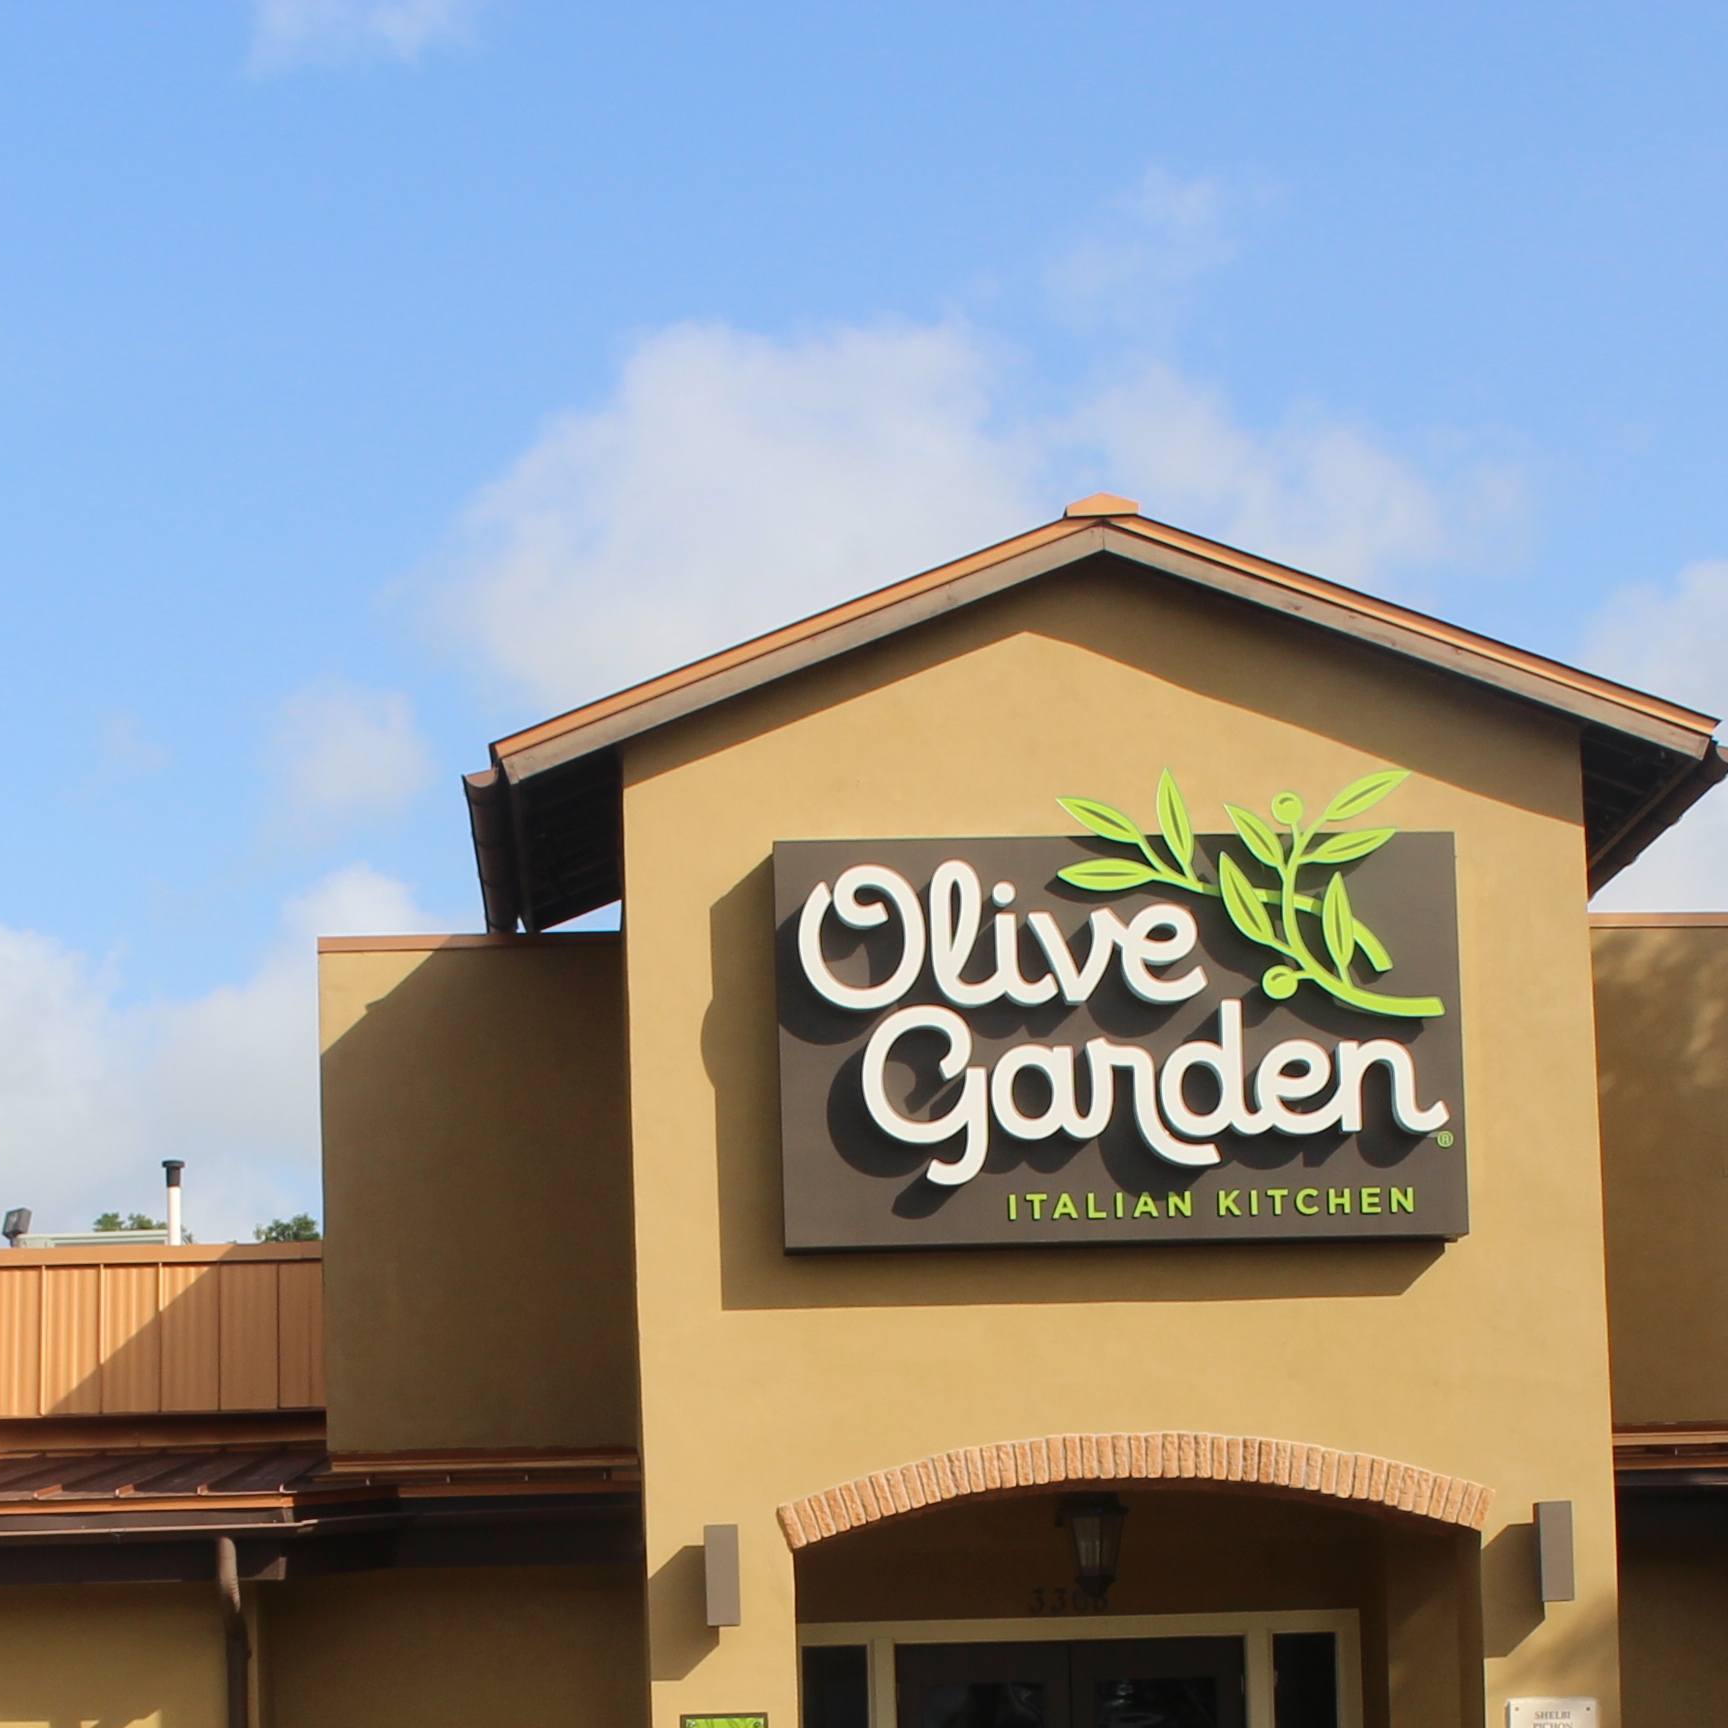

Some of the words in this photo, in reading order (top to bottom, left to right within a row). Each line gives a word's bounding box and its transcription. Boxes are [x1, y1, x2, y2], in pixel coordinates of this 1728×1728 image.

[798, 858, 1208, 1010] Olive
[862, 999, 1450, 1186] Garden
[1007, 1190, 1194, 1220] ITALIAN
[1217, 1186, 1416, 1217] KITCHEN
[1534, 1710, 1571, 1720] SHELBI
